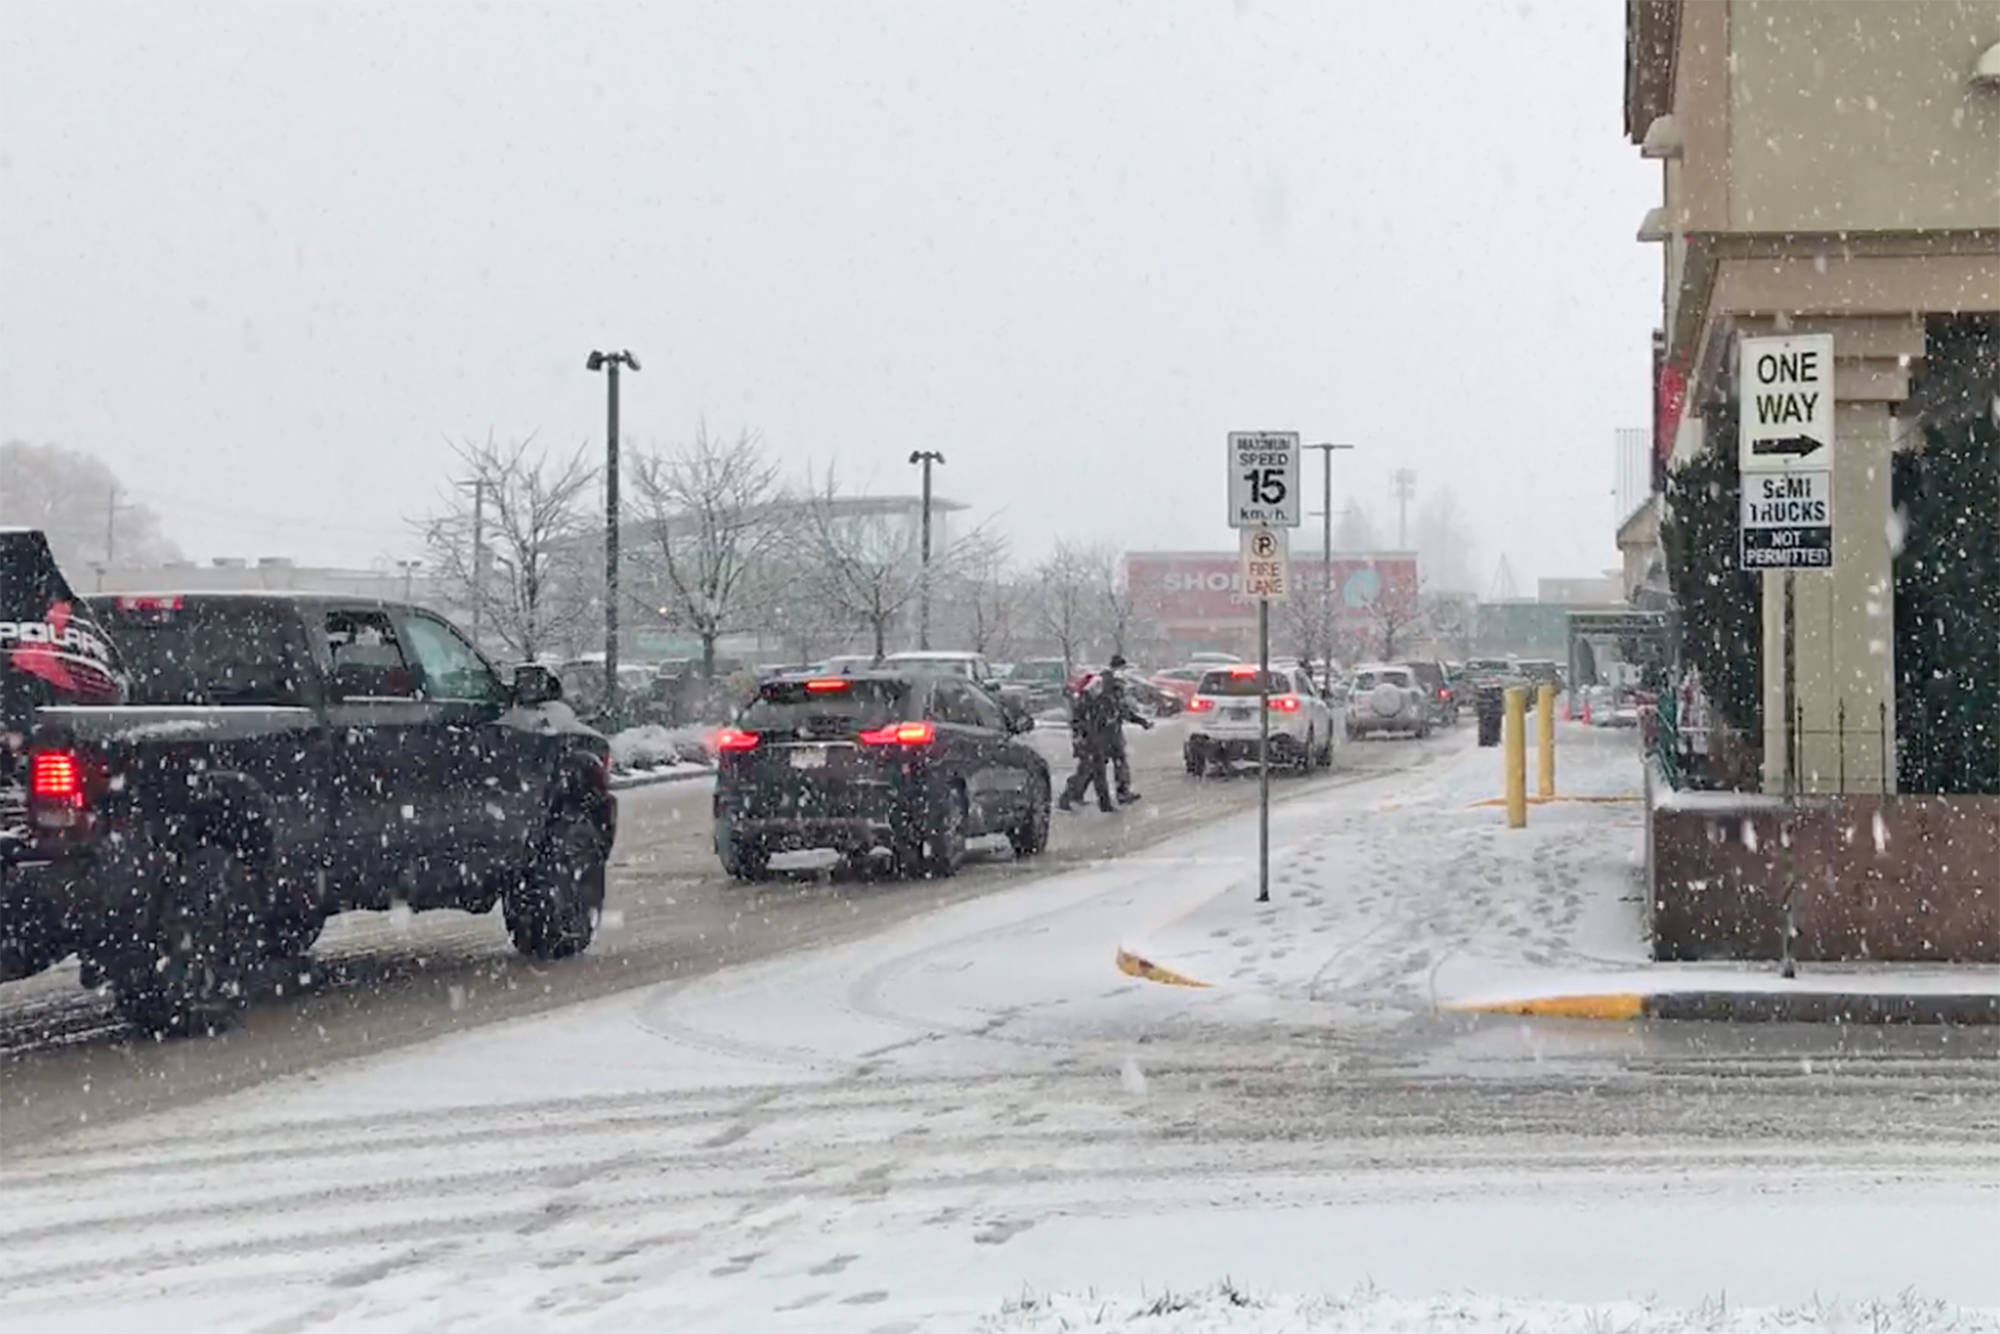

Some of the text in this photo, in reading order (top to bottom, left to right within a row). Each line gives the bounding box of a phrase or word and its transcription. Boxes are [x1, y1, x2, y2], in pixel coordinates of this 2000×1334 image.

[1757, 352, 1818, 384] ONE
[1756, 392, 1819, 424] WAY
[1239, 452, 1289, 467] SPEED
[1243, 468, 1287, 505] 15
[1762, 478, 1811, 499] SEMI
[1750, 501, 1826, 522] TRUCKS
[1771, 530, 1802, 547] NOT
[1746, 549, 1828, 565] PERMITTED
[1250, 562, 1281, 577] FIRE
[1246, 579, 1284, 595] LANE
[0, 621, 110, 663] POLAR
